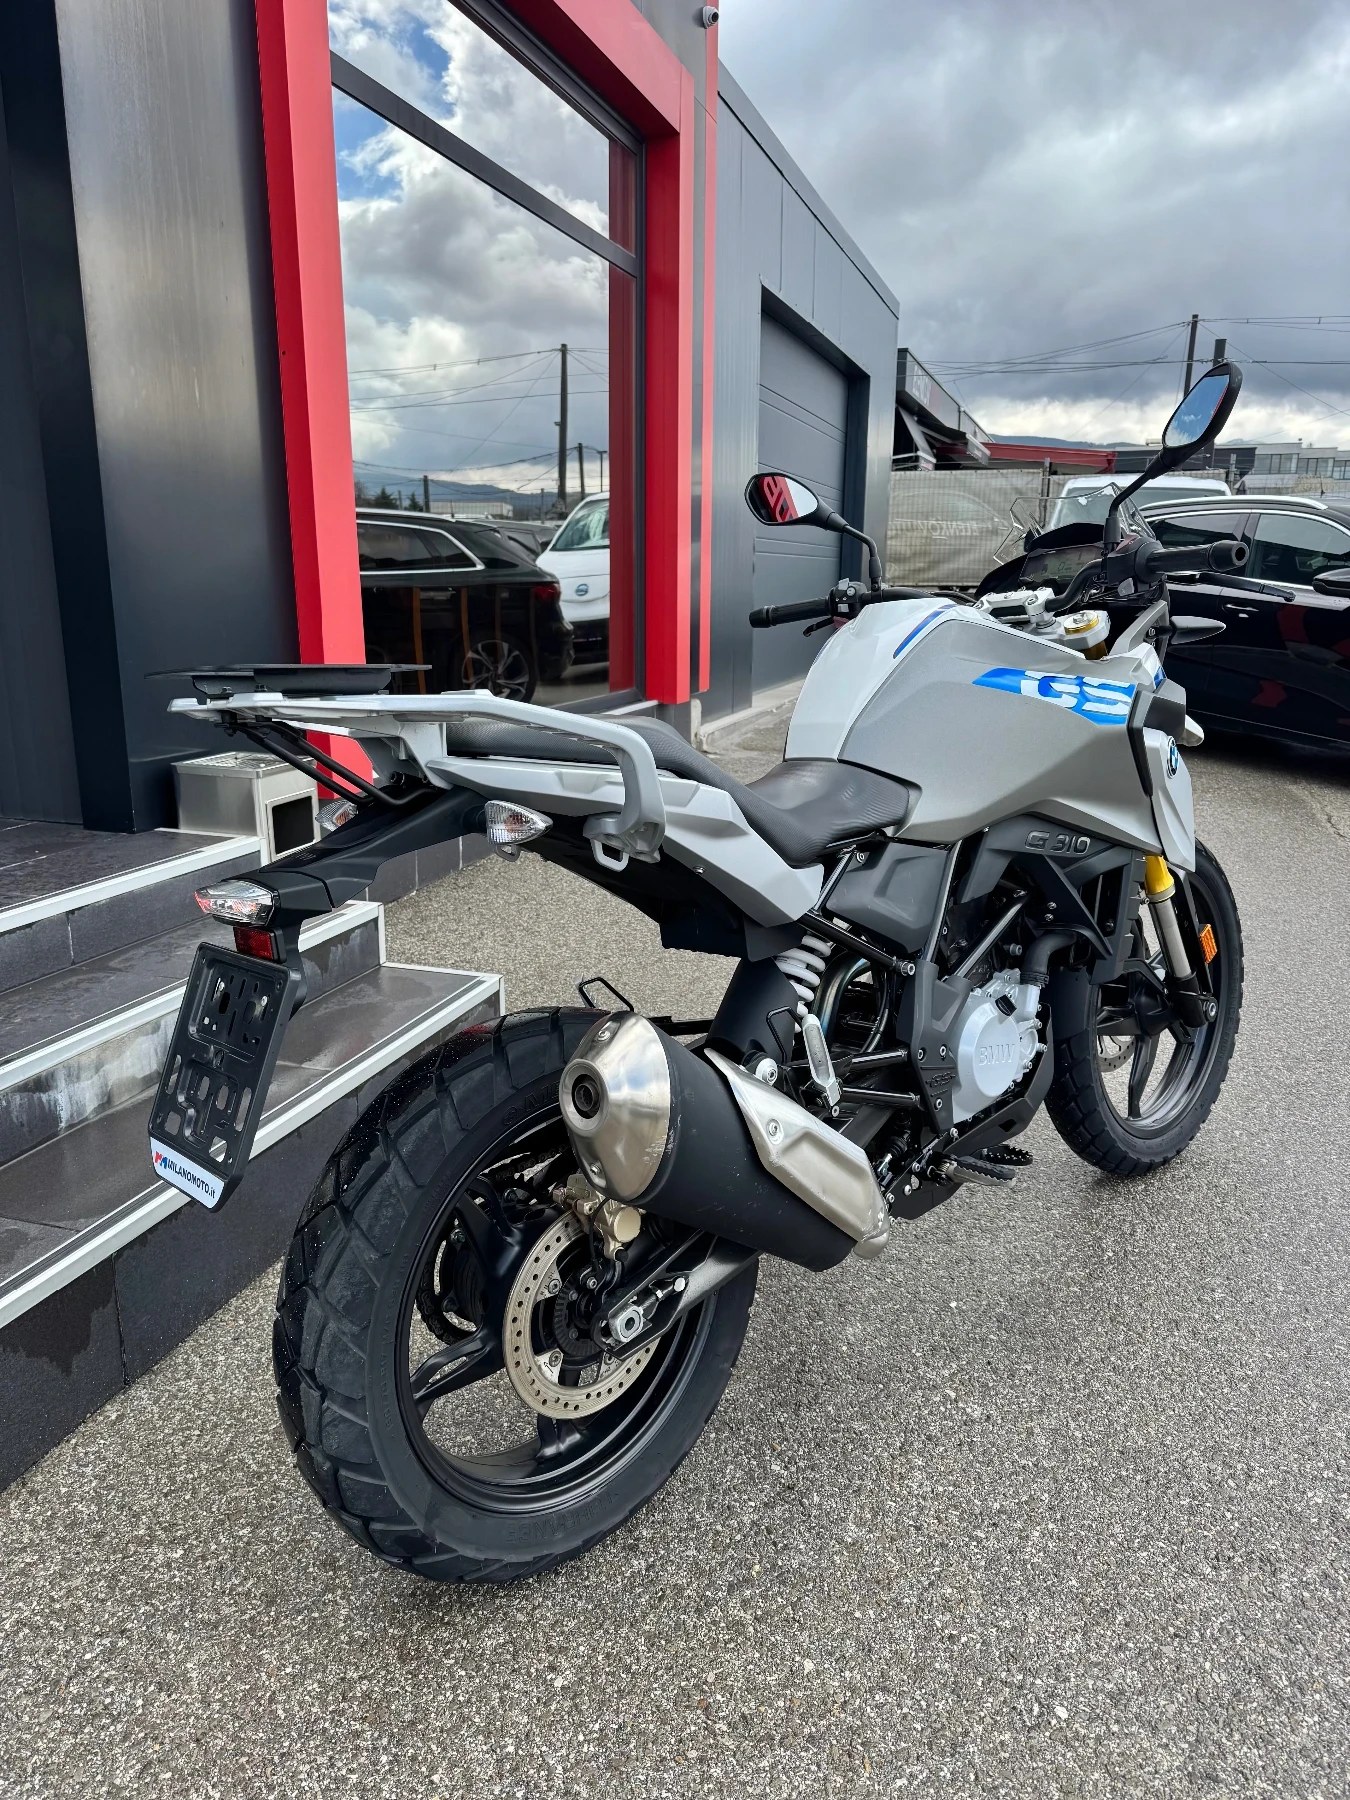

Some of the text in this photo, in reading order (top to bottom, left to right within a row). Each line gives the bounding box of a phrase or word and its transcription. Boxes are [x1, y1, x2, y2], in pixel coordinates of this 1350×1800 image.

[1020, 670, 1136, 716] GS
[1025, 830, 1090, 854] G 310
[978, 1042, 1016, 1067] BMW
